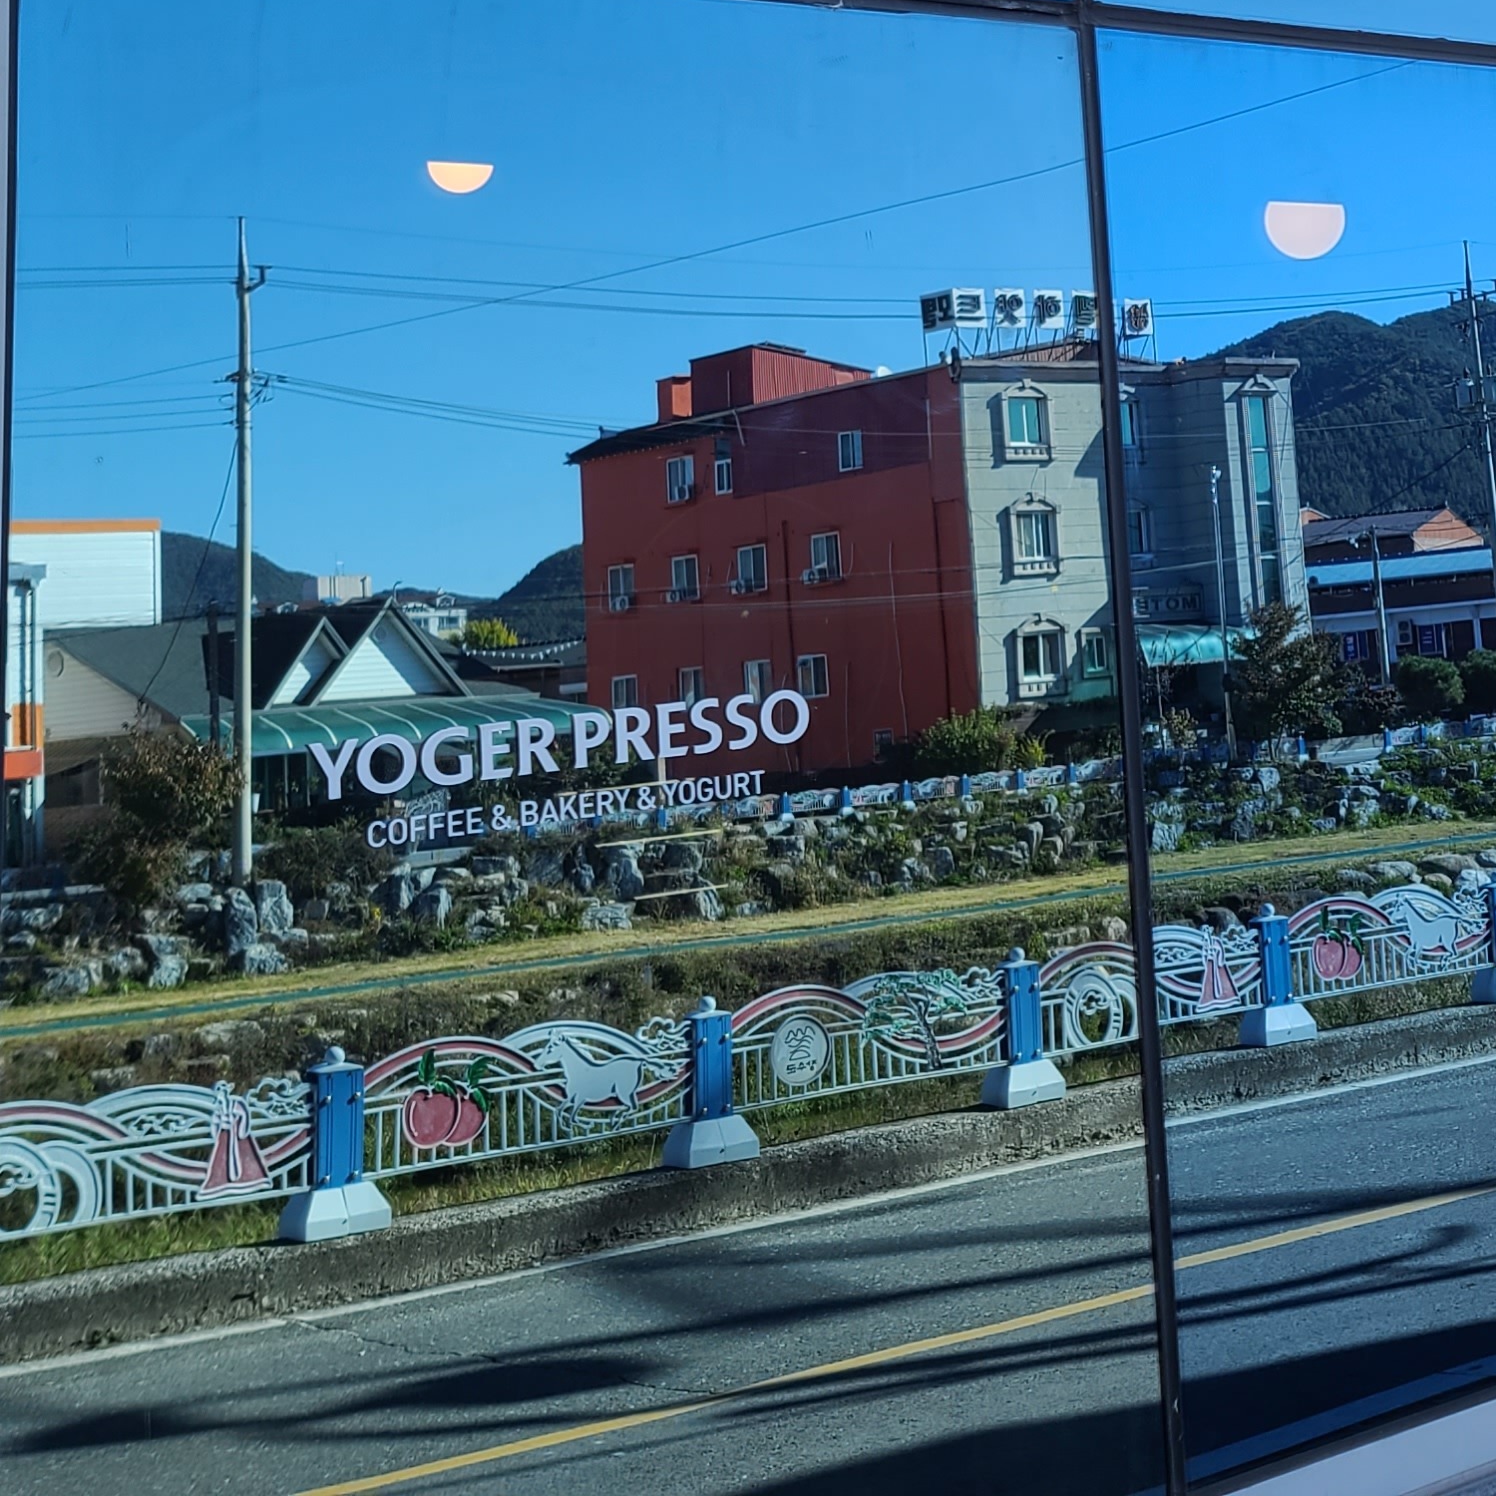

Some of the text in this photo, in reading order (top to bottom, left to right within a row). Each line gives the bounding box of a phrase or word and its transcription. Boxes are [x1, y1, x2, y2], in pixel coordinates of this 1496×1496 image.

[308, 689, 810, 801] YOGER PRESSO
[366, 770, 766, 849] COFFEE & BAKERY & YOGURT
